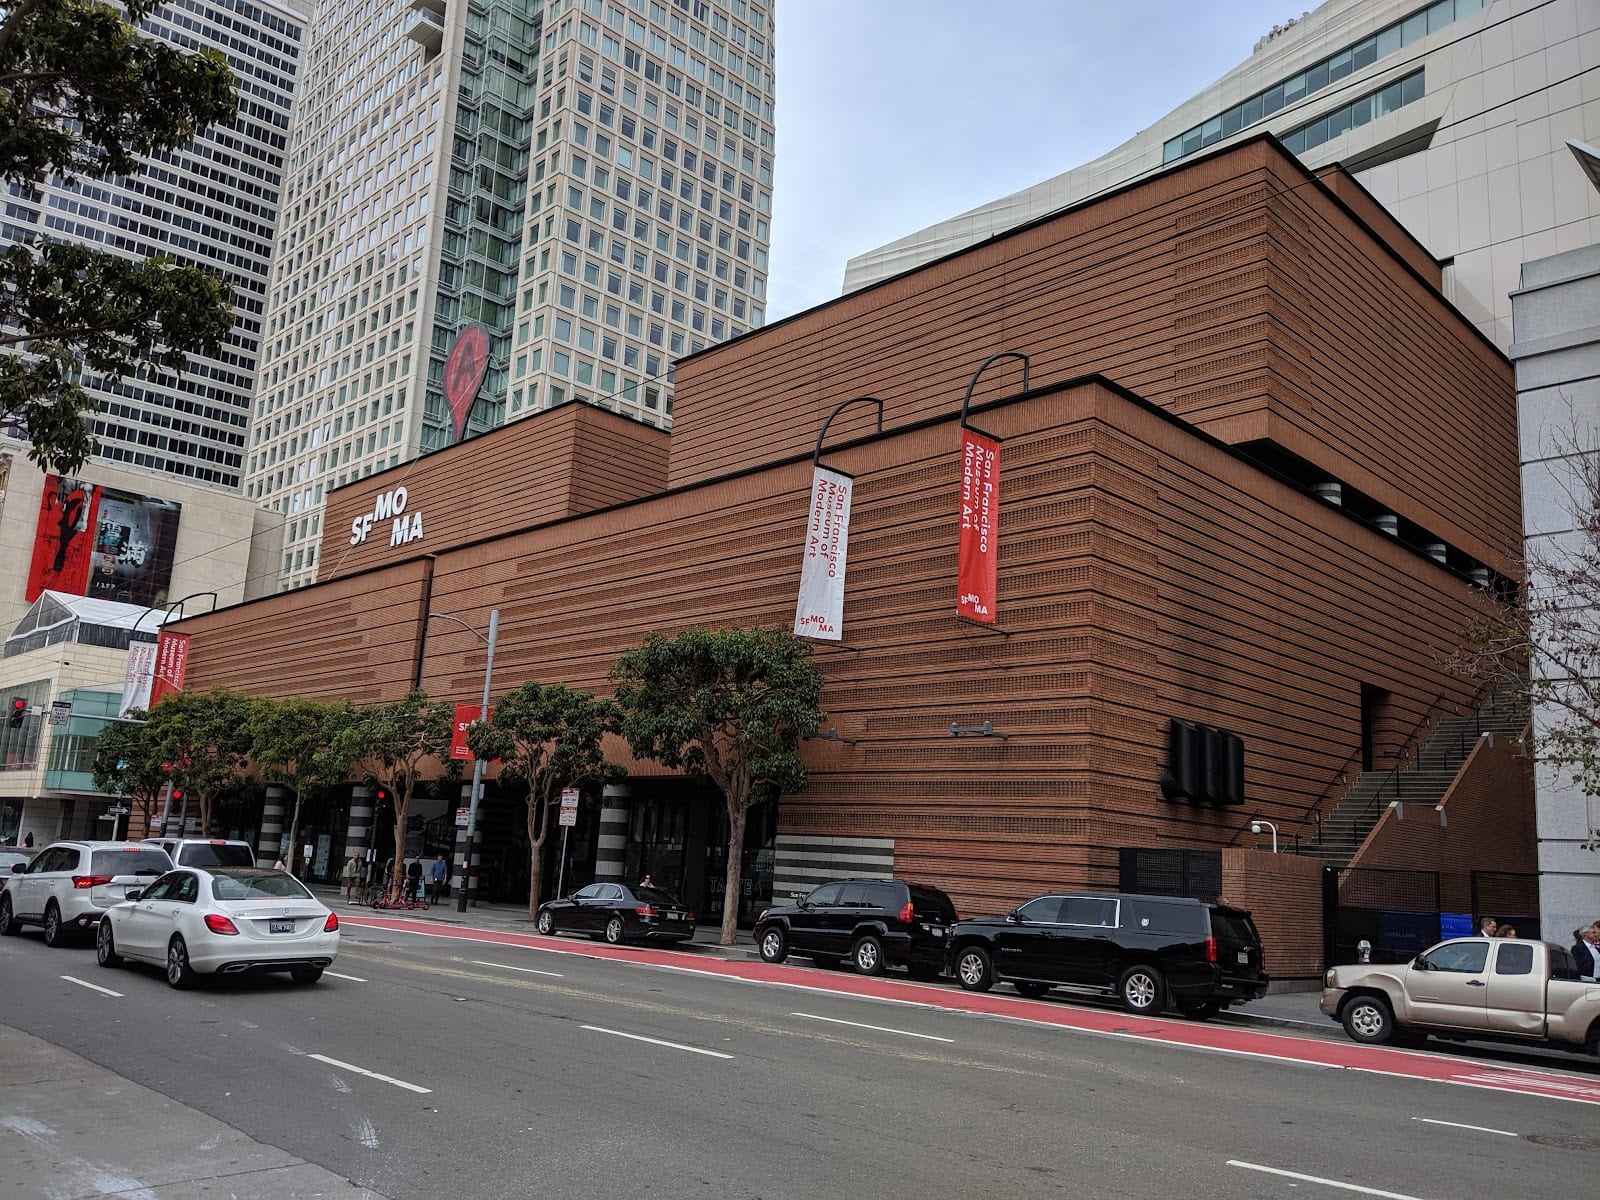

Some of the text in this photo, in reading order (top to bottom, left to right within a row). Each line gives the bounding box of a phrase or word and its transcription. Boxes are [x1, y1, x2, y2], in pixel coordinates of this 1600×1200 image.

[452, 341, 475, 391] A
[962, 442, 975, 529] Modern Art
[973, 445, 984, 532] Museum of
[980, 450, 995, 553] San Francisco
[374, 486, 408, 522] MO
[809, 479, 828, 558] Modern Art
[820, 482, 837, 559] Museum of
[349, 513, 374, 546] SF
[390, 511, 424, 547] MA
[828, 485, 847, 578] San Francisco
[800, 617, 810, 625] SF
[810, 615, 825, 624] MO
[974, 604, 988, 615] MA
[818, 624, 834, 633] MA
[160, 637, 171, 665] Modern
[169, 638, 178, 669] Museum
[173, 640, 186, 687] San Francisco
